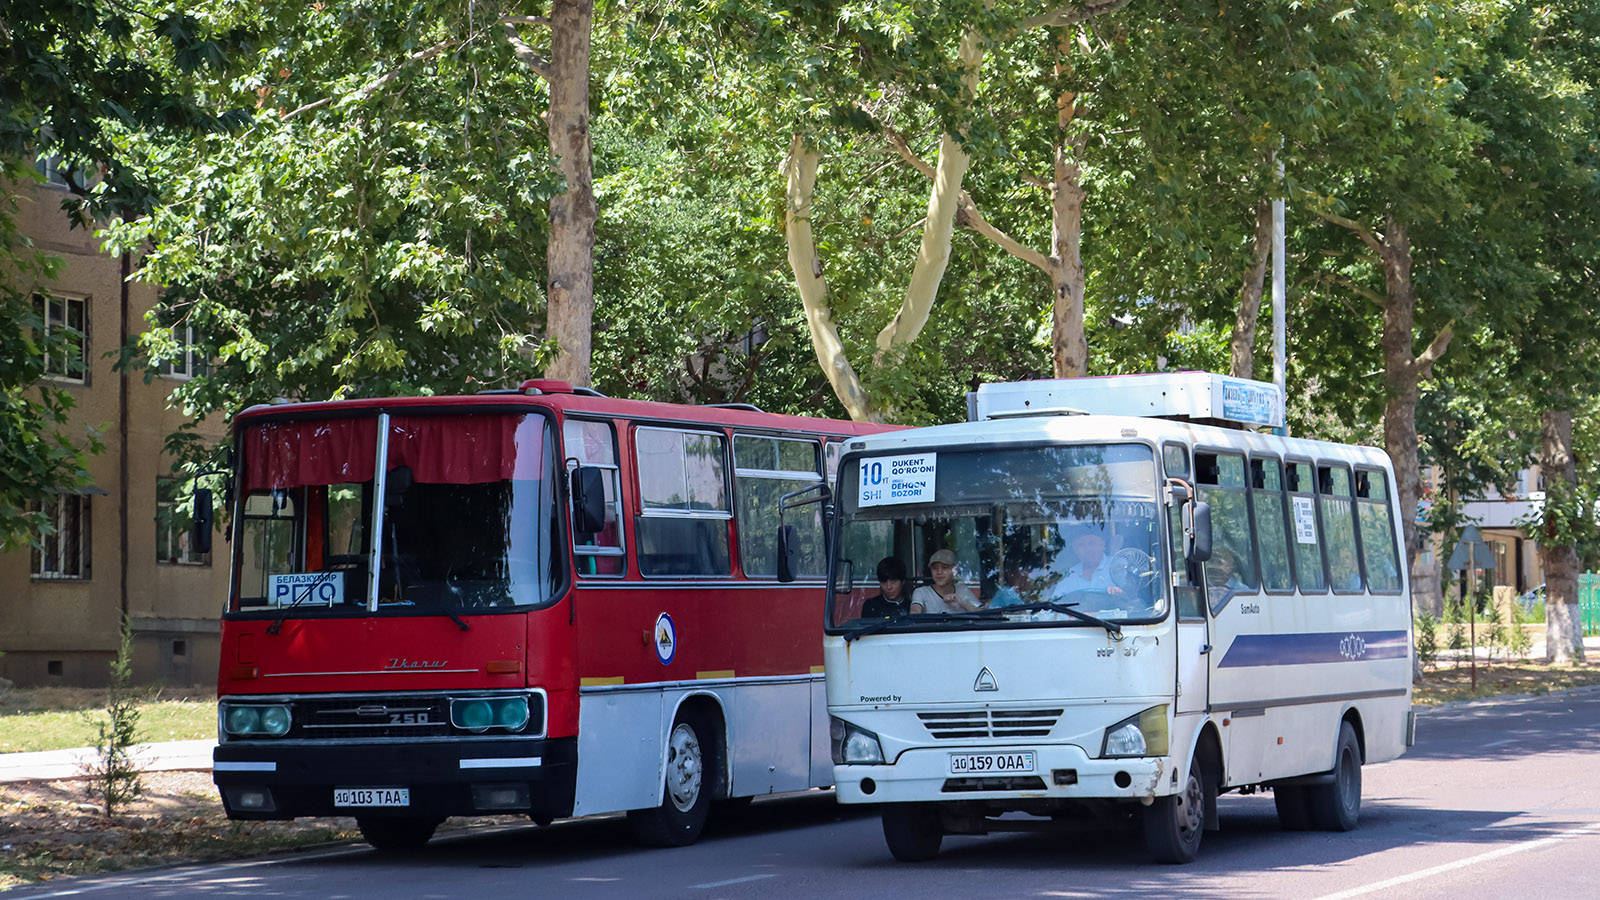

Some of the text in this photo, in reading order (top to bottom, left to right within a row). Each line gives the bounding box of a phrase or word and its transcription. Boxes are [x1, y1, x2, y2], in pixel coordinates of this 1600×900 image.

[892, 459, 925, 467] DUKENT
[861, 461, 882, 486] 10
[891, 481, 926, 490] DEHQON
[863, 485, 882, 501] SHI
[891, 489, 922, 498] BOZORI
[1096, 647, 1139, 657] NP 37
[384, 658, 448, 669] Ikarus
[389, 713, 429, 725] 250
[954, 758, 967, 770] 10
[969, 756, 993, 771] 159
[337, 790, 402, 804] 10 103 TAA
